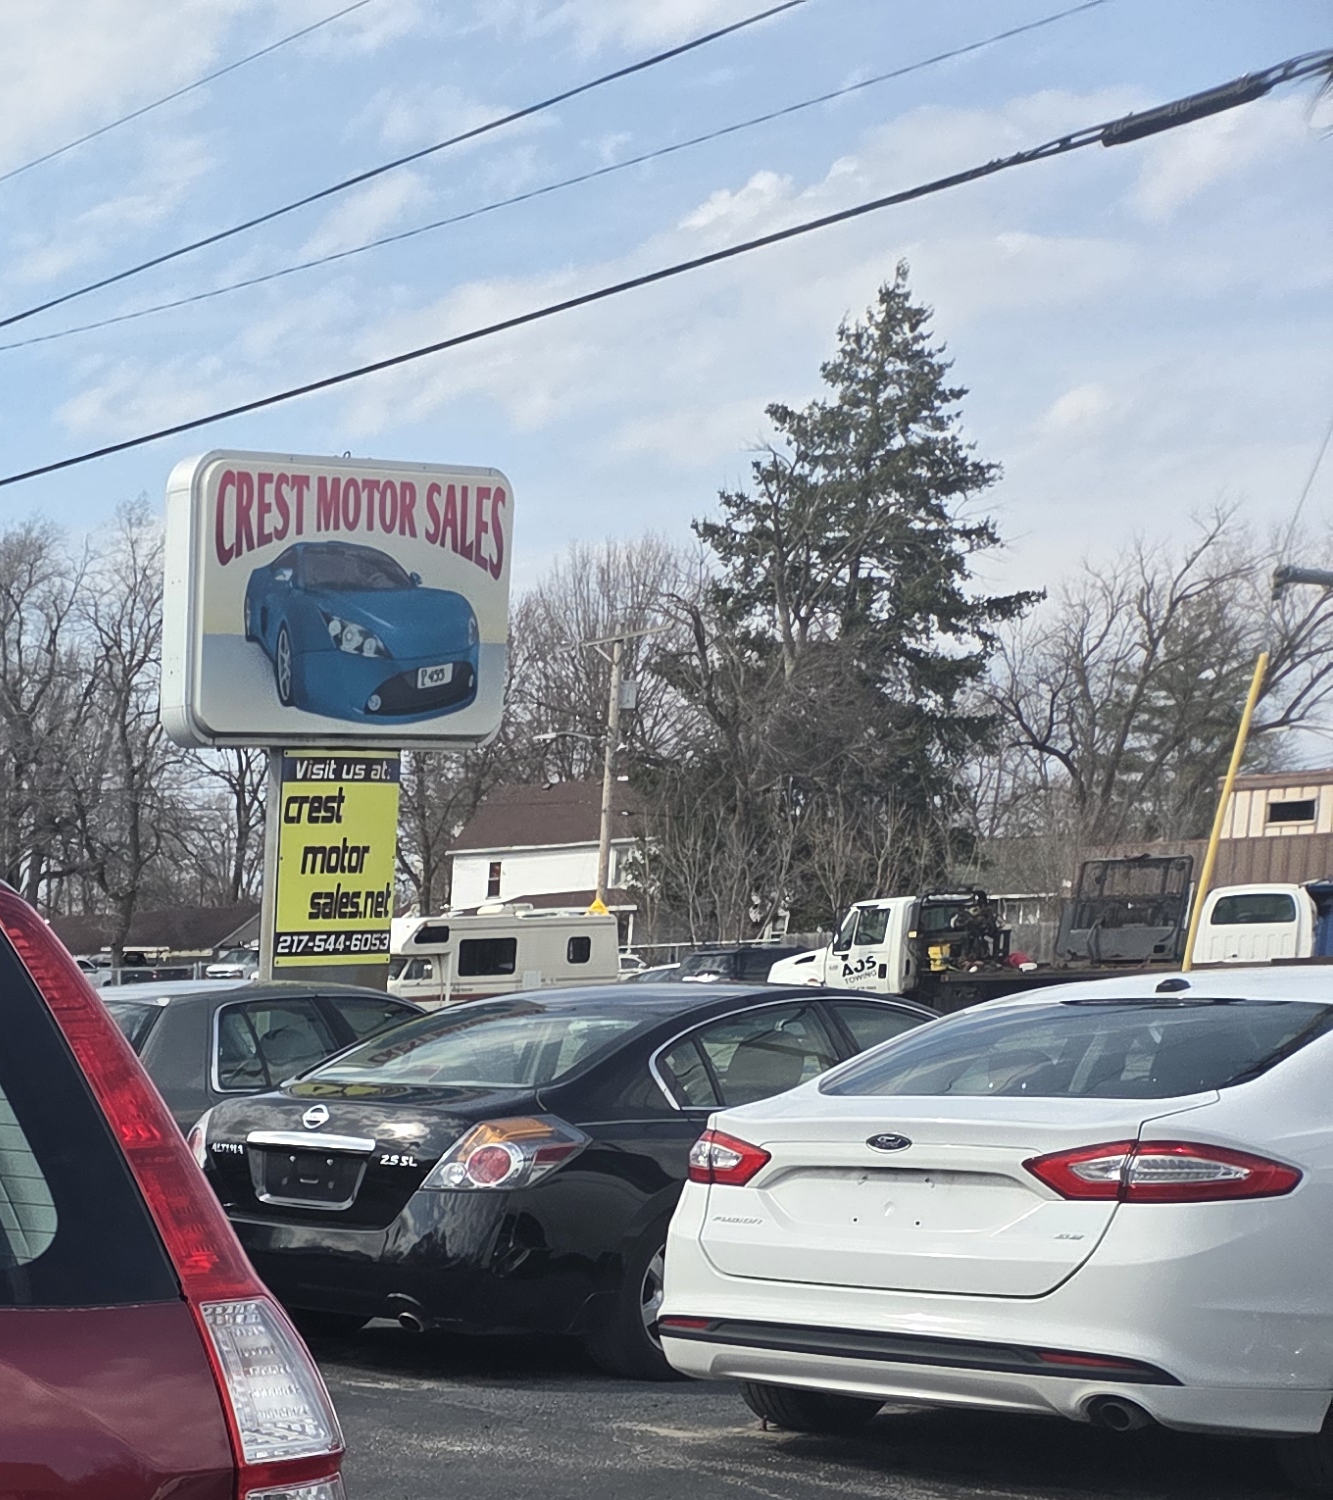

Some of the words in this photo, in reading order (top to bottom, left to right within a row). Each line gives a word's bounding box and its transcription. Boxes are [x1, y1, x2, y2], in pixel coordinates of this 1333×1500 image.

[214, 469, 310, 567] CREST
[316, 475, 418, 540] MOTOR
[423, 481, 507, 582] SALES
[295, 759, 337, 781] Visit
[341, 764, 367, 780] us
[283, 786, 346, 825] crest
[300, 837, 371, 875] motor
[308, 881, 393, 921] sales.net
[277, 932, 390, 954] 217-544-6053
[844, 969, 878, 985] TOWING
[211, 1141, 244, 1156] ALTIMA
